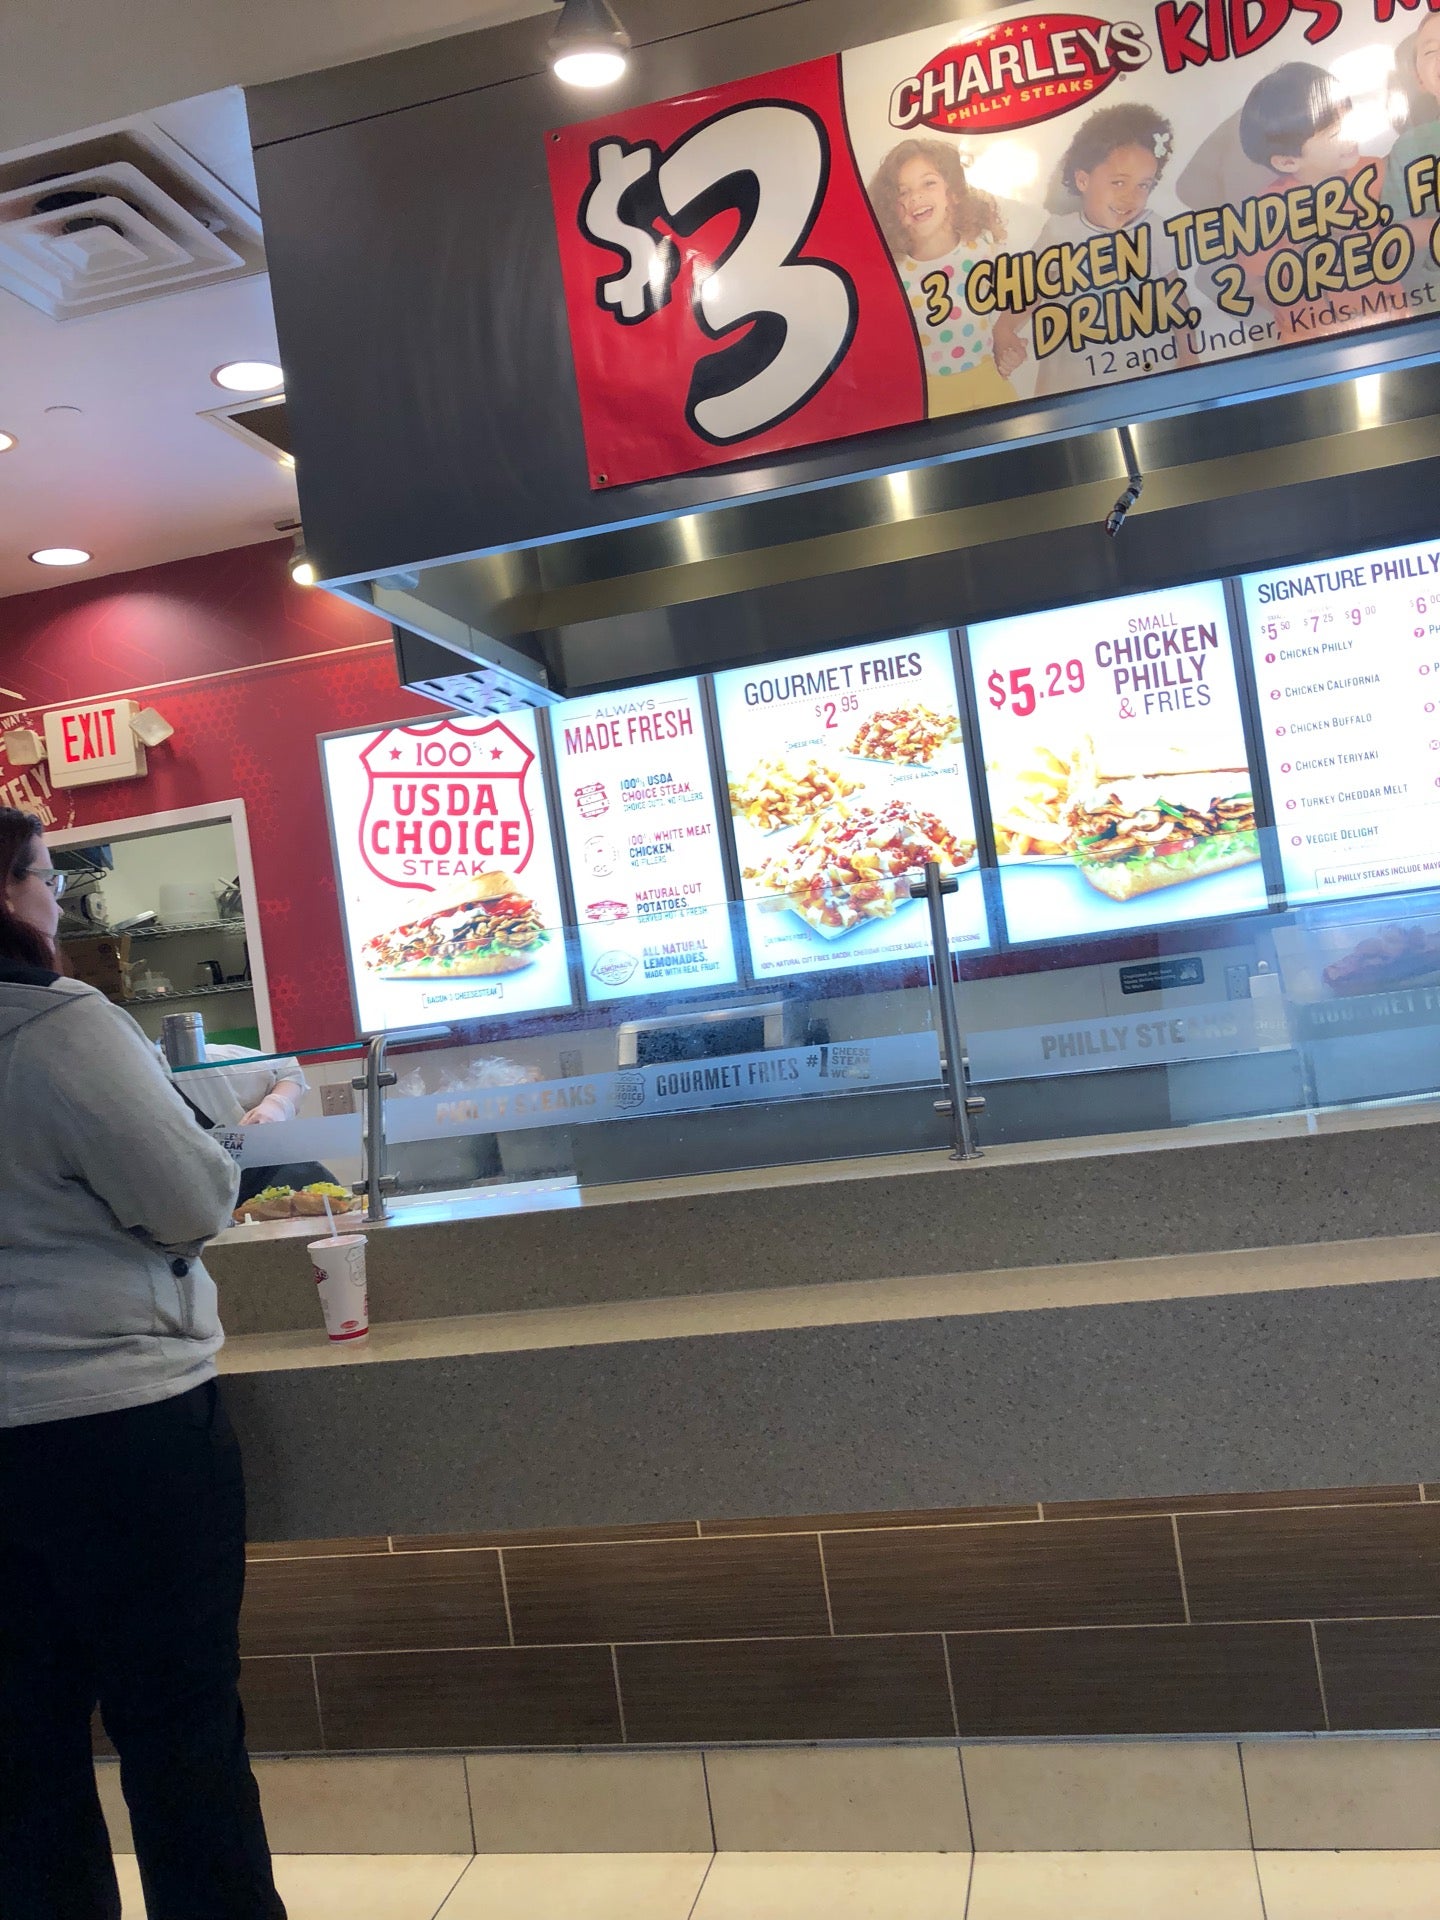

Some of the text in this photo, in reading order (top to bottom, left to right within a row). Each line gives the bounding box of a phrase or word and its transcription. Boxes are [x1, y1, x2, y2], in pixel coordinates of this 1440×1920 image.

[1155, 0, 1342, 74] KIDS
[889, 21, 1152, 130] CHARLEYS
[947, 79, 1095, 124] PHILLY STEAKS
[921, 270, 953, 327] 3
[965, 222, 1151, 316] CHICKEN
[1163, 163, 1394, 270] TENDERS,
[1404, 154, 1440, 217] F
[580, 100, 858, 445] $3
[1032, 278, 1202, 360] DRINK,
[1211, 264, 1254, 316] 2
[1265, 223, 1414, 306] OREO
[1085, 283, 1437, 376] 12 and Under, Kids Must
[1258, 552, 1440, 604] SIGNATURE PHILLY
[1128, 612, 1178, 634] SMALL
[1094, 621, 1220, 668] CHICKEN
[744, 652, 922, 706] GOURMET FRIES
[987, 658, 1086, 717] $5.29
[1113, 653, 1207, 695] PHILLY
[595, 699, 656, 719] ALWAYS
[1118, 684, 1212, 719] & FRIES
[61, 708, 117, 763] EXIT
[564, 707, 693, 756] MADE FRESH
[622, 787, 657, 802] CHOICE
[647, 773, 673, 785] USDA
[392, 783, 499, 817] USDA
[370, 819, 521, 857] CHOICE
[654, 828, 684, 842] WHITE
[686, 824, 712, 837] MEAT
[402, 859, 487, 878] STEAK
[1324, 874, 1336, 885] ALL
[1337, 871, 1361, 883] PHILLY
[1362, 868, 1390, 880] STEAKS
[1391, 864, 1421, 875] INCLUDE
[635, 882, 702, 901] NATURAL CUT
[643, 939, 708, 957] ALL NATURAL
[645, 970, 664, 979] MADE
[832, 1047, 870, 1056] CHEESE
[1040, 1025, 1128, 1060] PHILLY
[656, 1058, 799, 1097] GOURMET FRIES
[806, 1047, 829, 1078] #1
